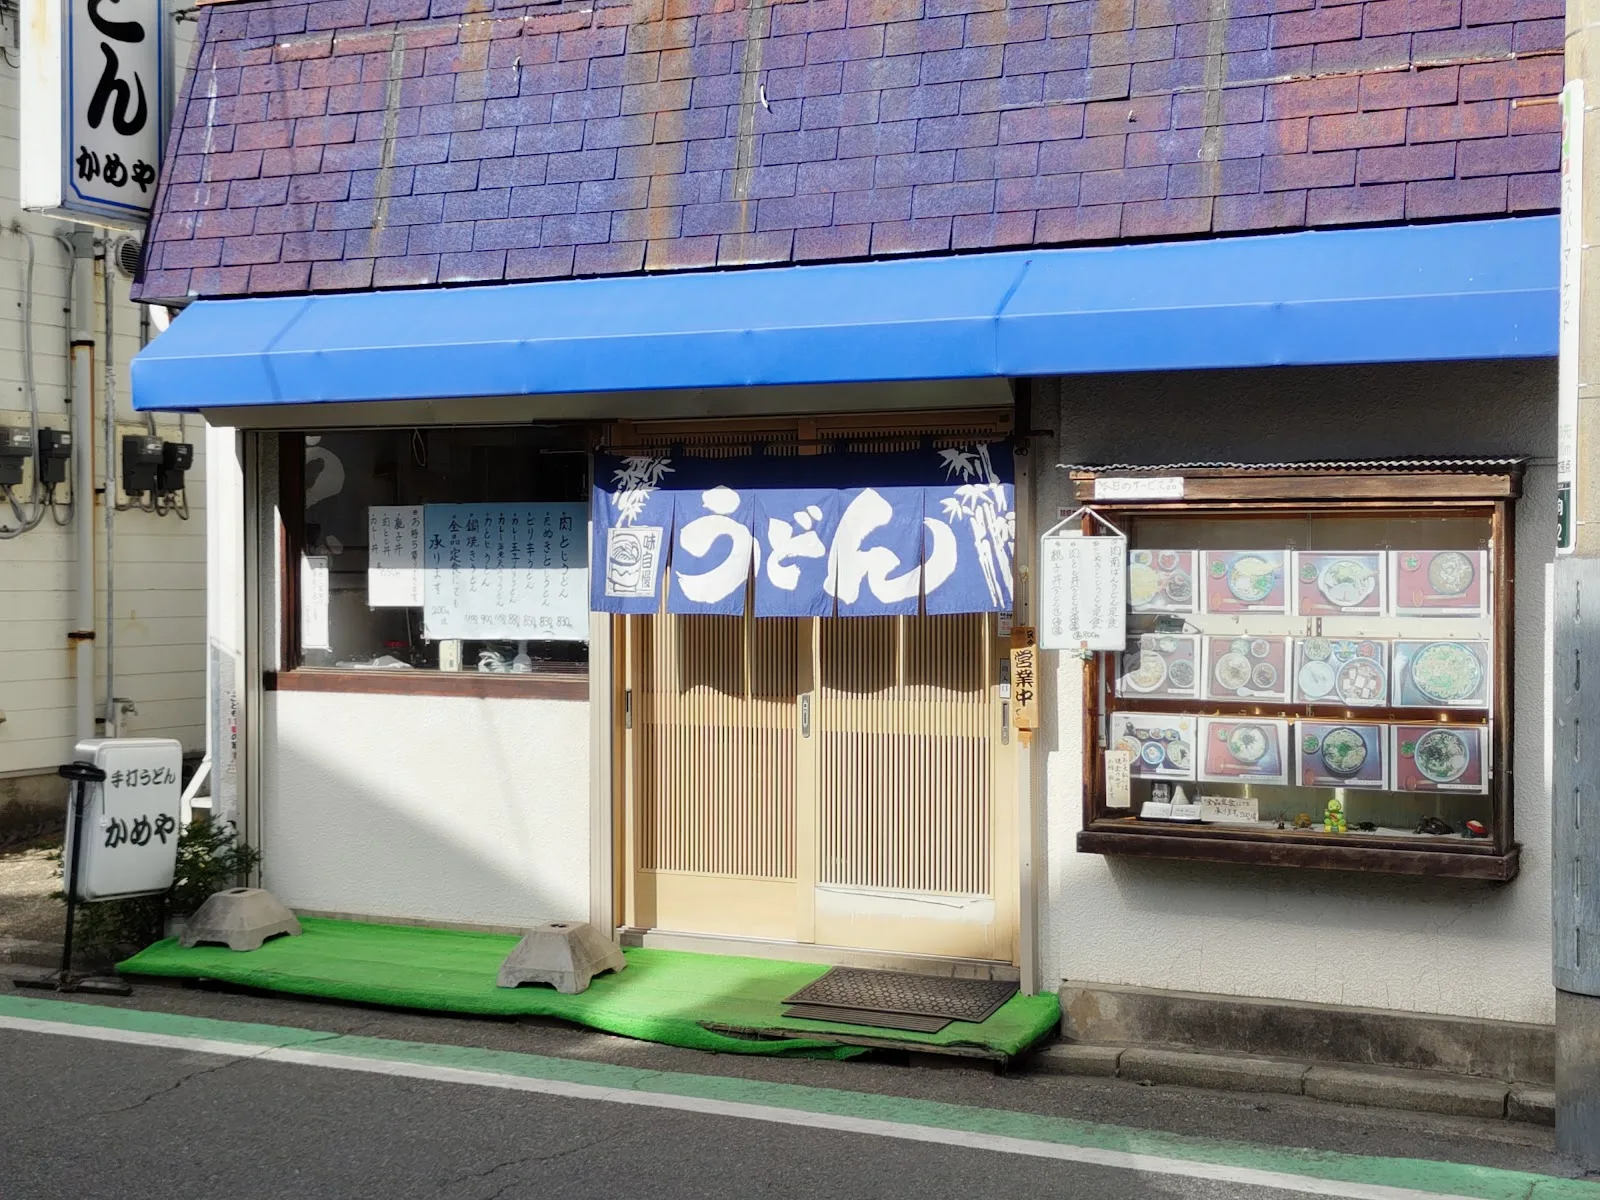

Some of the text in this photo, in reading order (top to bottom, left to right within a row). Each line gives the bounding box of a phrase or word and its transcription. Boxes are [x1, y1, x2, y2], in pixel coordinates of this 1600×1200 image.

[75, 145, 156, 193] かめや
[641, 532, 657, 589] 味自慢
[674, 484, 958, 605] うどん
[1014, 648, 1035, 707] 営業中
[110, 766, 177, 789] 手打うどん
[104, 813, 176, 849] かめや
